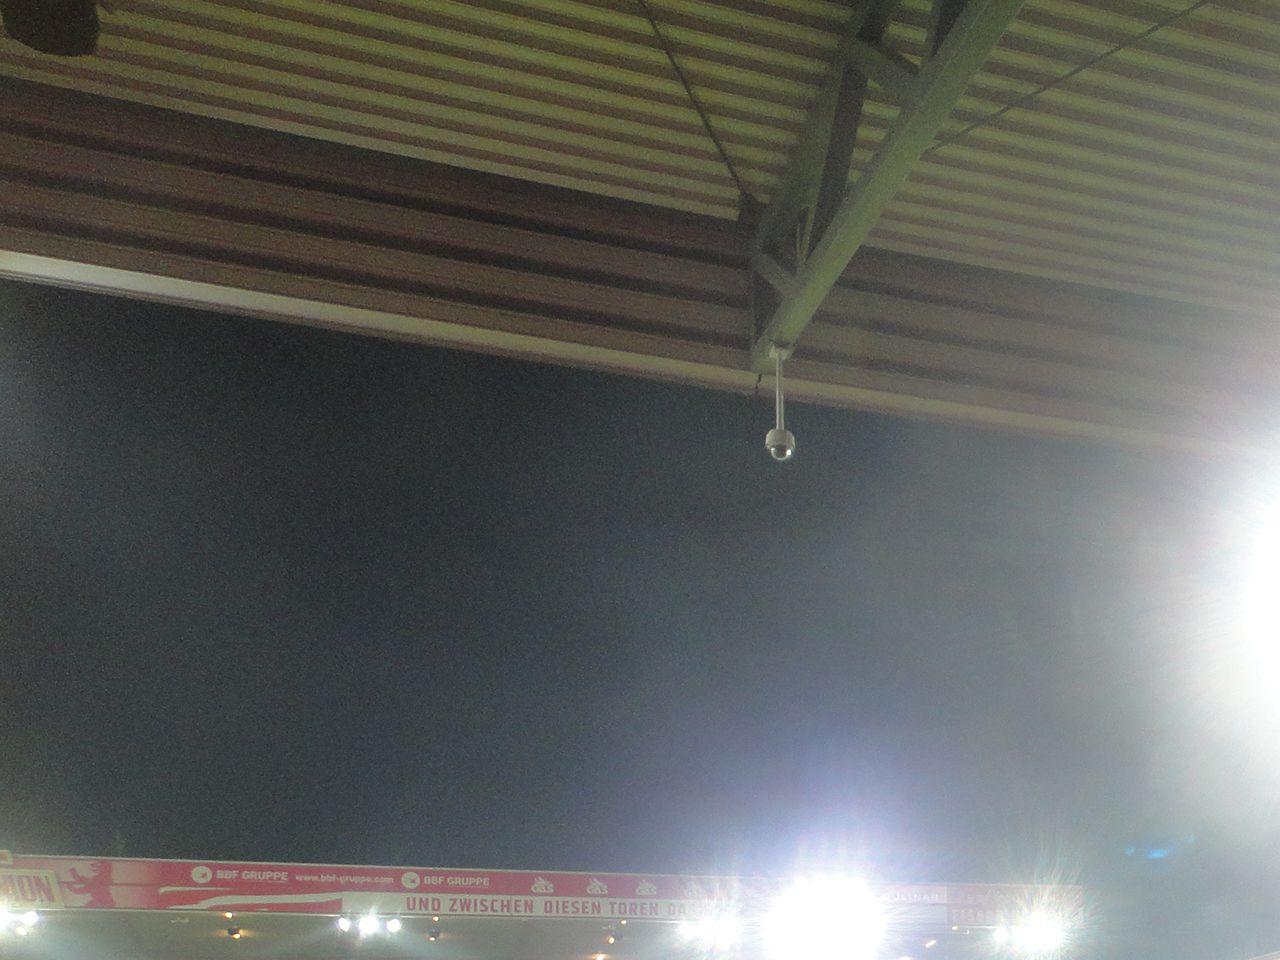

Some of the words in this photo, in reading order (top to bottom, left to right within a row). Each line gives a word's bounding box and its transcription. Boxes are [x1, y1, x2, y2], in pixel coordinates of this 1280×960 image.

[242, 871, 289, 881] GRUPPE
[447, 876, 490, 887] GRUPPE
[406, 896, 441, 911] UND
[449, 898, 534, 913] ZWISCHEN
[544, 900, 600, 915] DIESEN
[609, 902, 659, 916] TOREN
